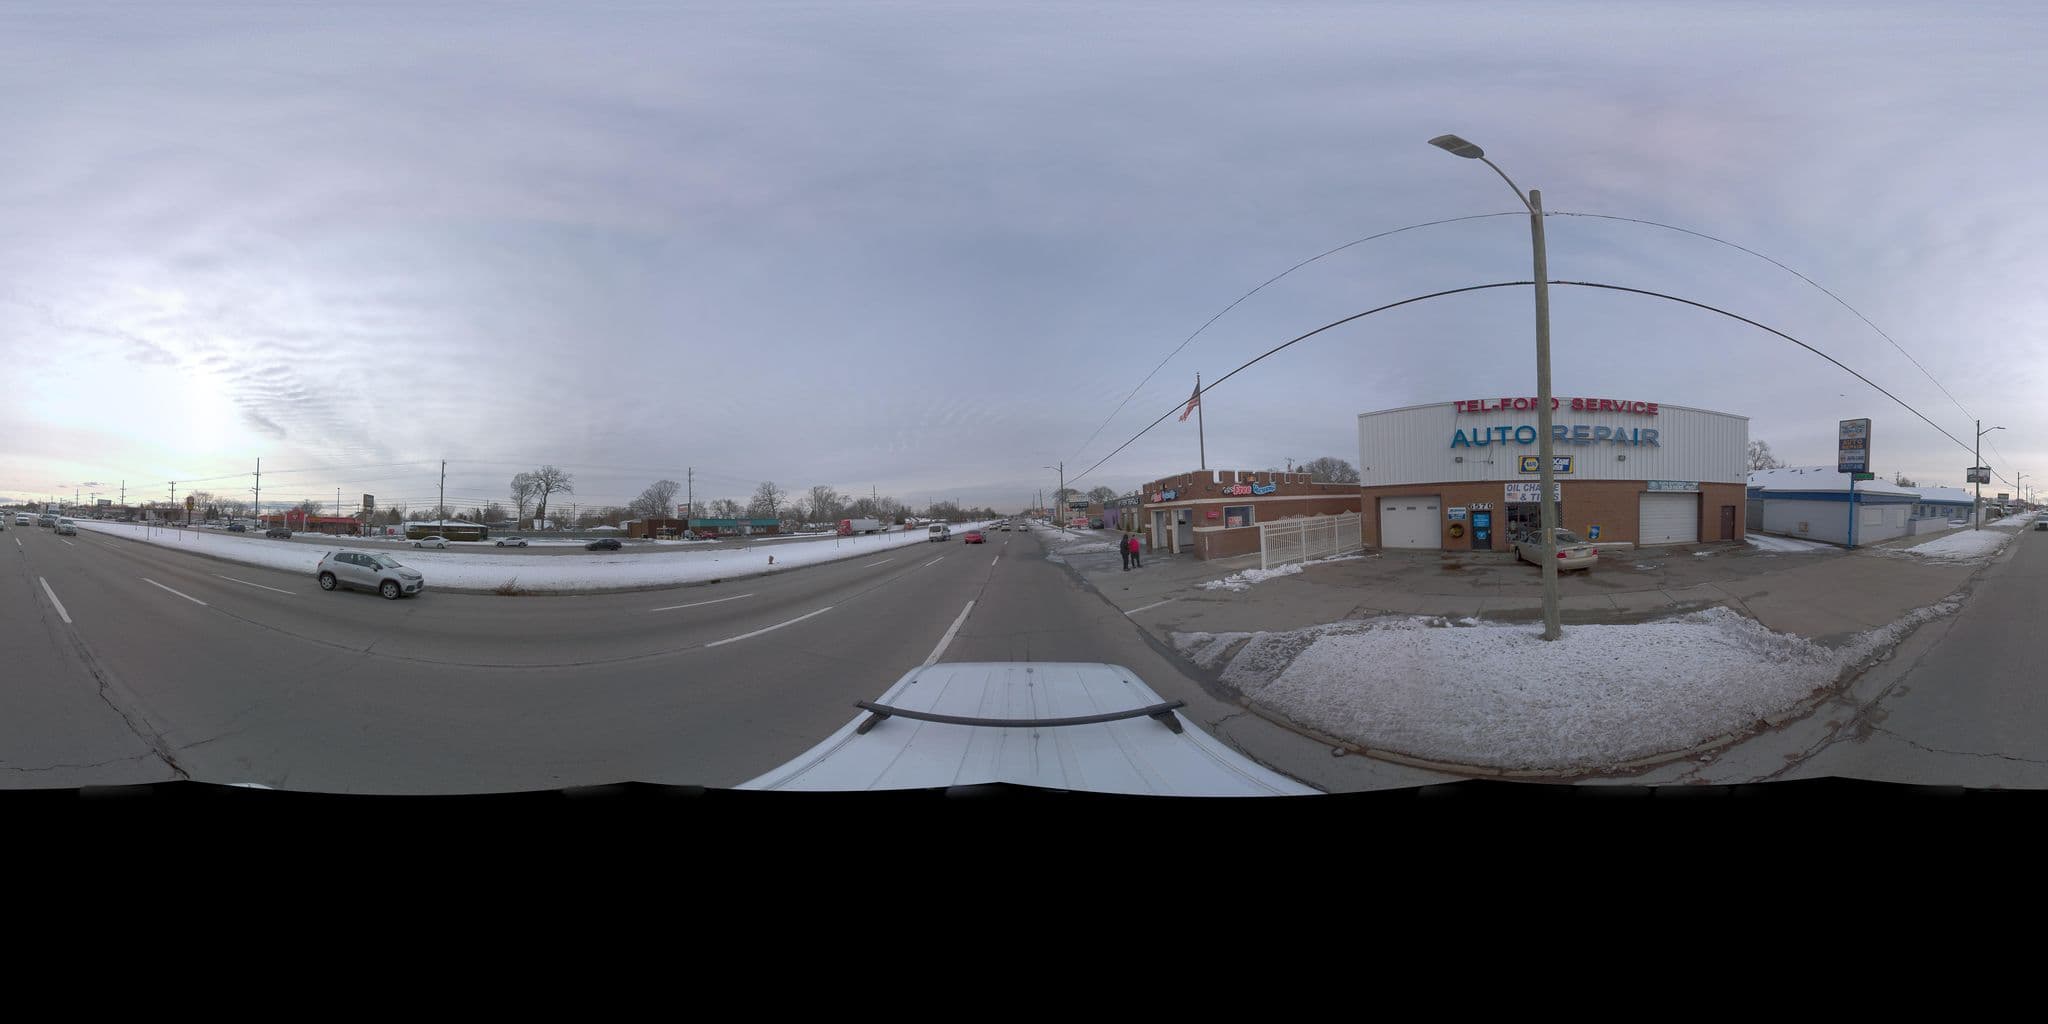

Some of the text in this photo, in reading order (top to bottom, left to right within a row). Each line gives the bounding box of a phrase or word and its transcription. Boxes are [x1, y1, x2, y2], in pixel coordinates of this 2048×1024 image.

[1571, 398, 1658, 415] SERVICE
[1451, 424, 1661, 448] AUTO REPAIR
[1507, 483, 1560, 491] OIL CHAE
[1520, 493, 1560, 501] & TIS
